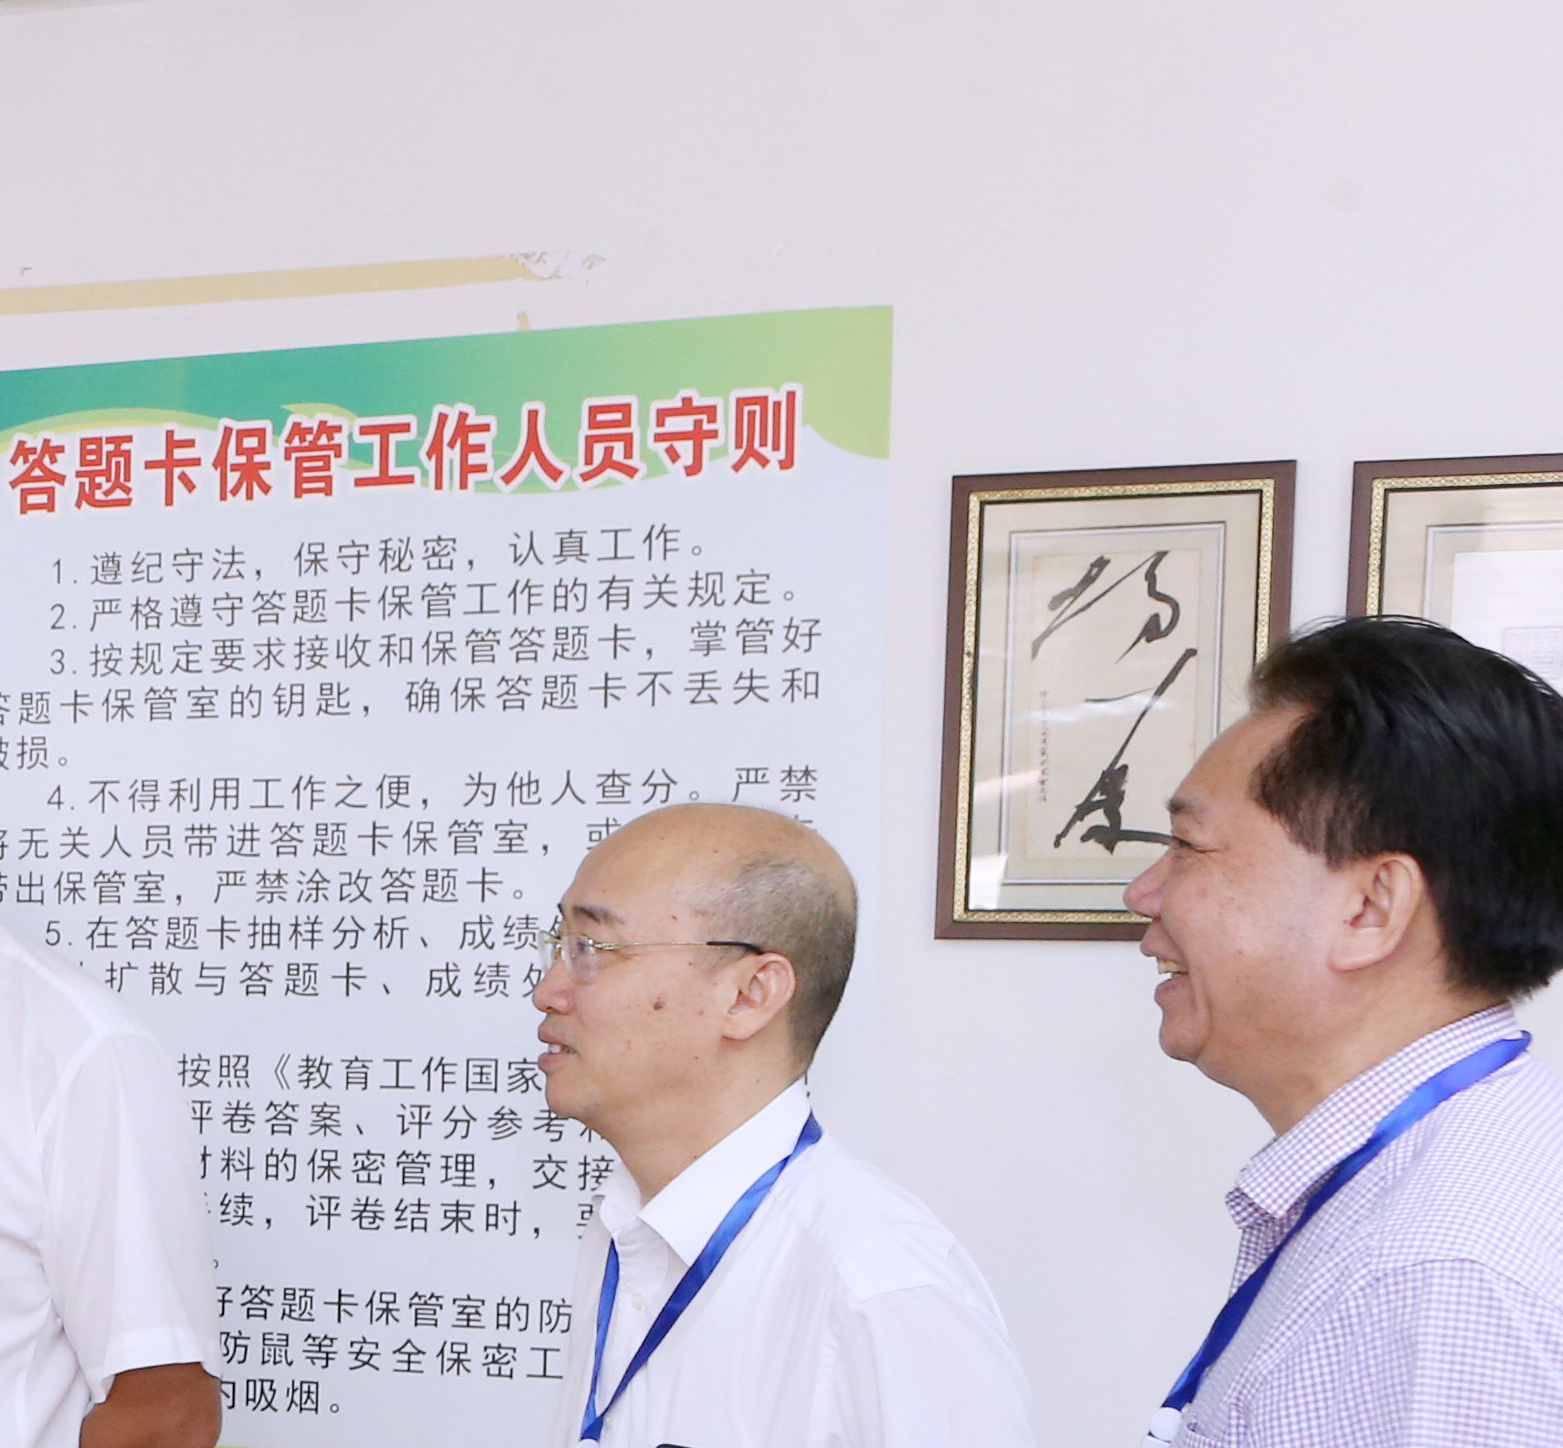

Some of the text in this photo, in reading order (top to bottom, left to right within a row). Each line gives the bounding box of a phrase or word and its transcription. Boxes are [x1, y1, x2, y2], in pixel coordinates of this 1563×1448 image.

[5, 388, 800, 516] 答题卡保管工作人员守则
[51, 522, 708, 588] 1.遵纪守法，保守秘密，认真工作。
[49, 568, 806, 634] 2.严格遵守答题卡保管工作的有关规定。
[49, 616, 824, 679] 3.按规定要求接收和保管答题卡，掌管好
